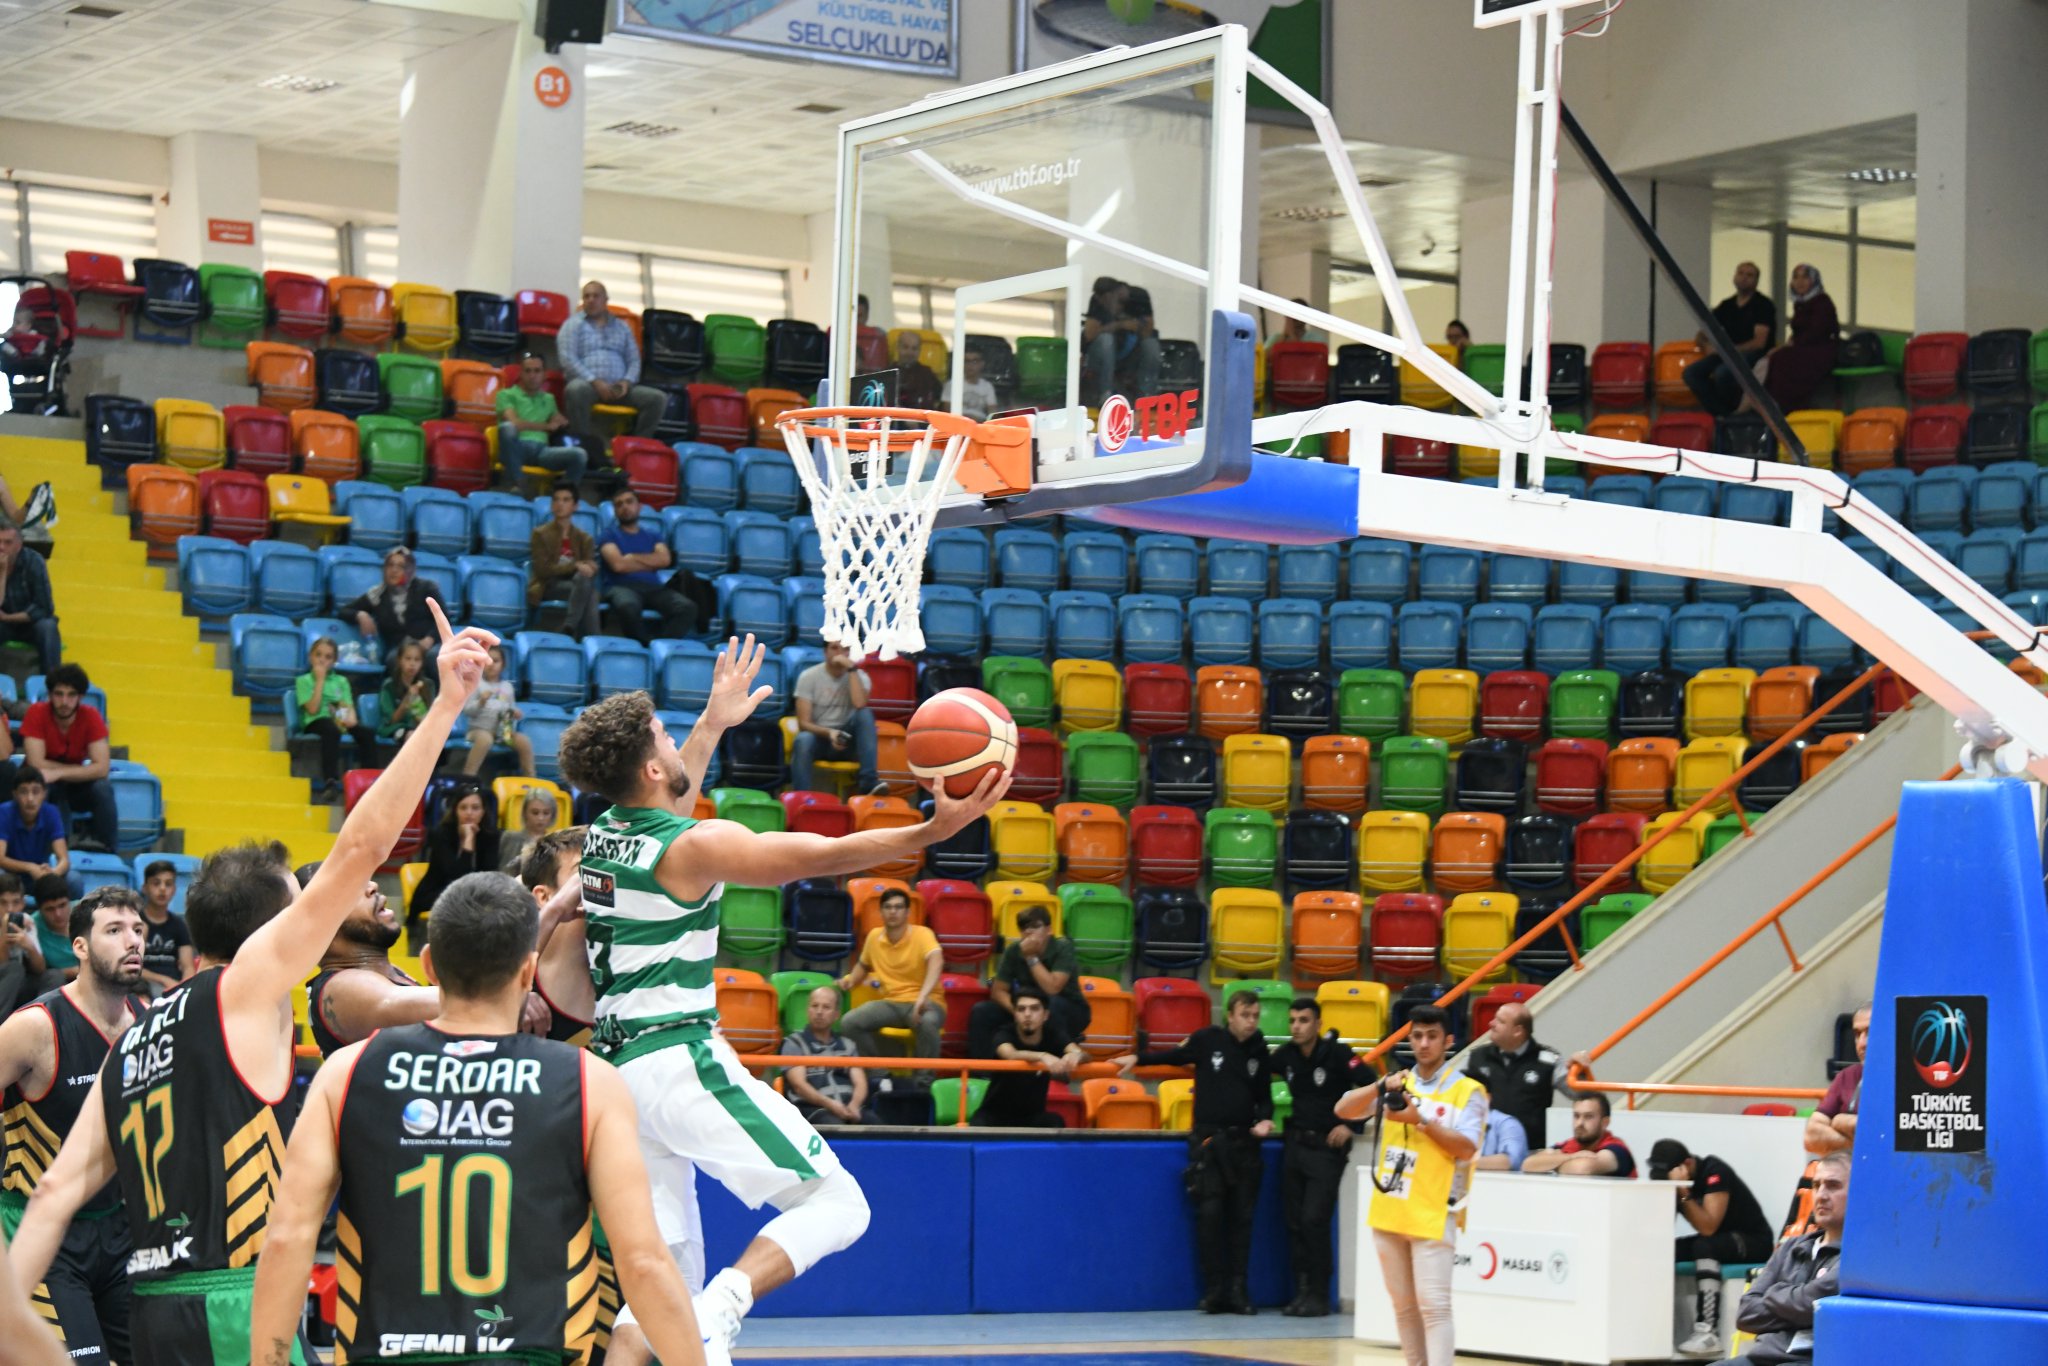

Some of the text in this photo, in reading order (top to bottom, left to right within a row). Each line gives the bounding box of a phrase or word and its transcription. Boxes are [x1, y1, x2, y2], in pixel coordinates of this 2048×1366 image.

[539, 74, 564, 93] B1
[1135, 388, 1199, 442] TBF
[583, 873, 602, 889] ATM
[384, 1052, 541, 1094] SERDAR
[1911, 1092, 1971, 1113] TÜRKİYE
[438, 1098, 515, 1136] IAG
[1899, 1112, 1984, 1131] BASKETBOL
[1926, 1129, 1954, 1149] LİGİ
[120, 1082, 174, 1221] 17
[395, 1153, 512, 1297] 10
[1503, 1257, 1543, 1273] MASASI
